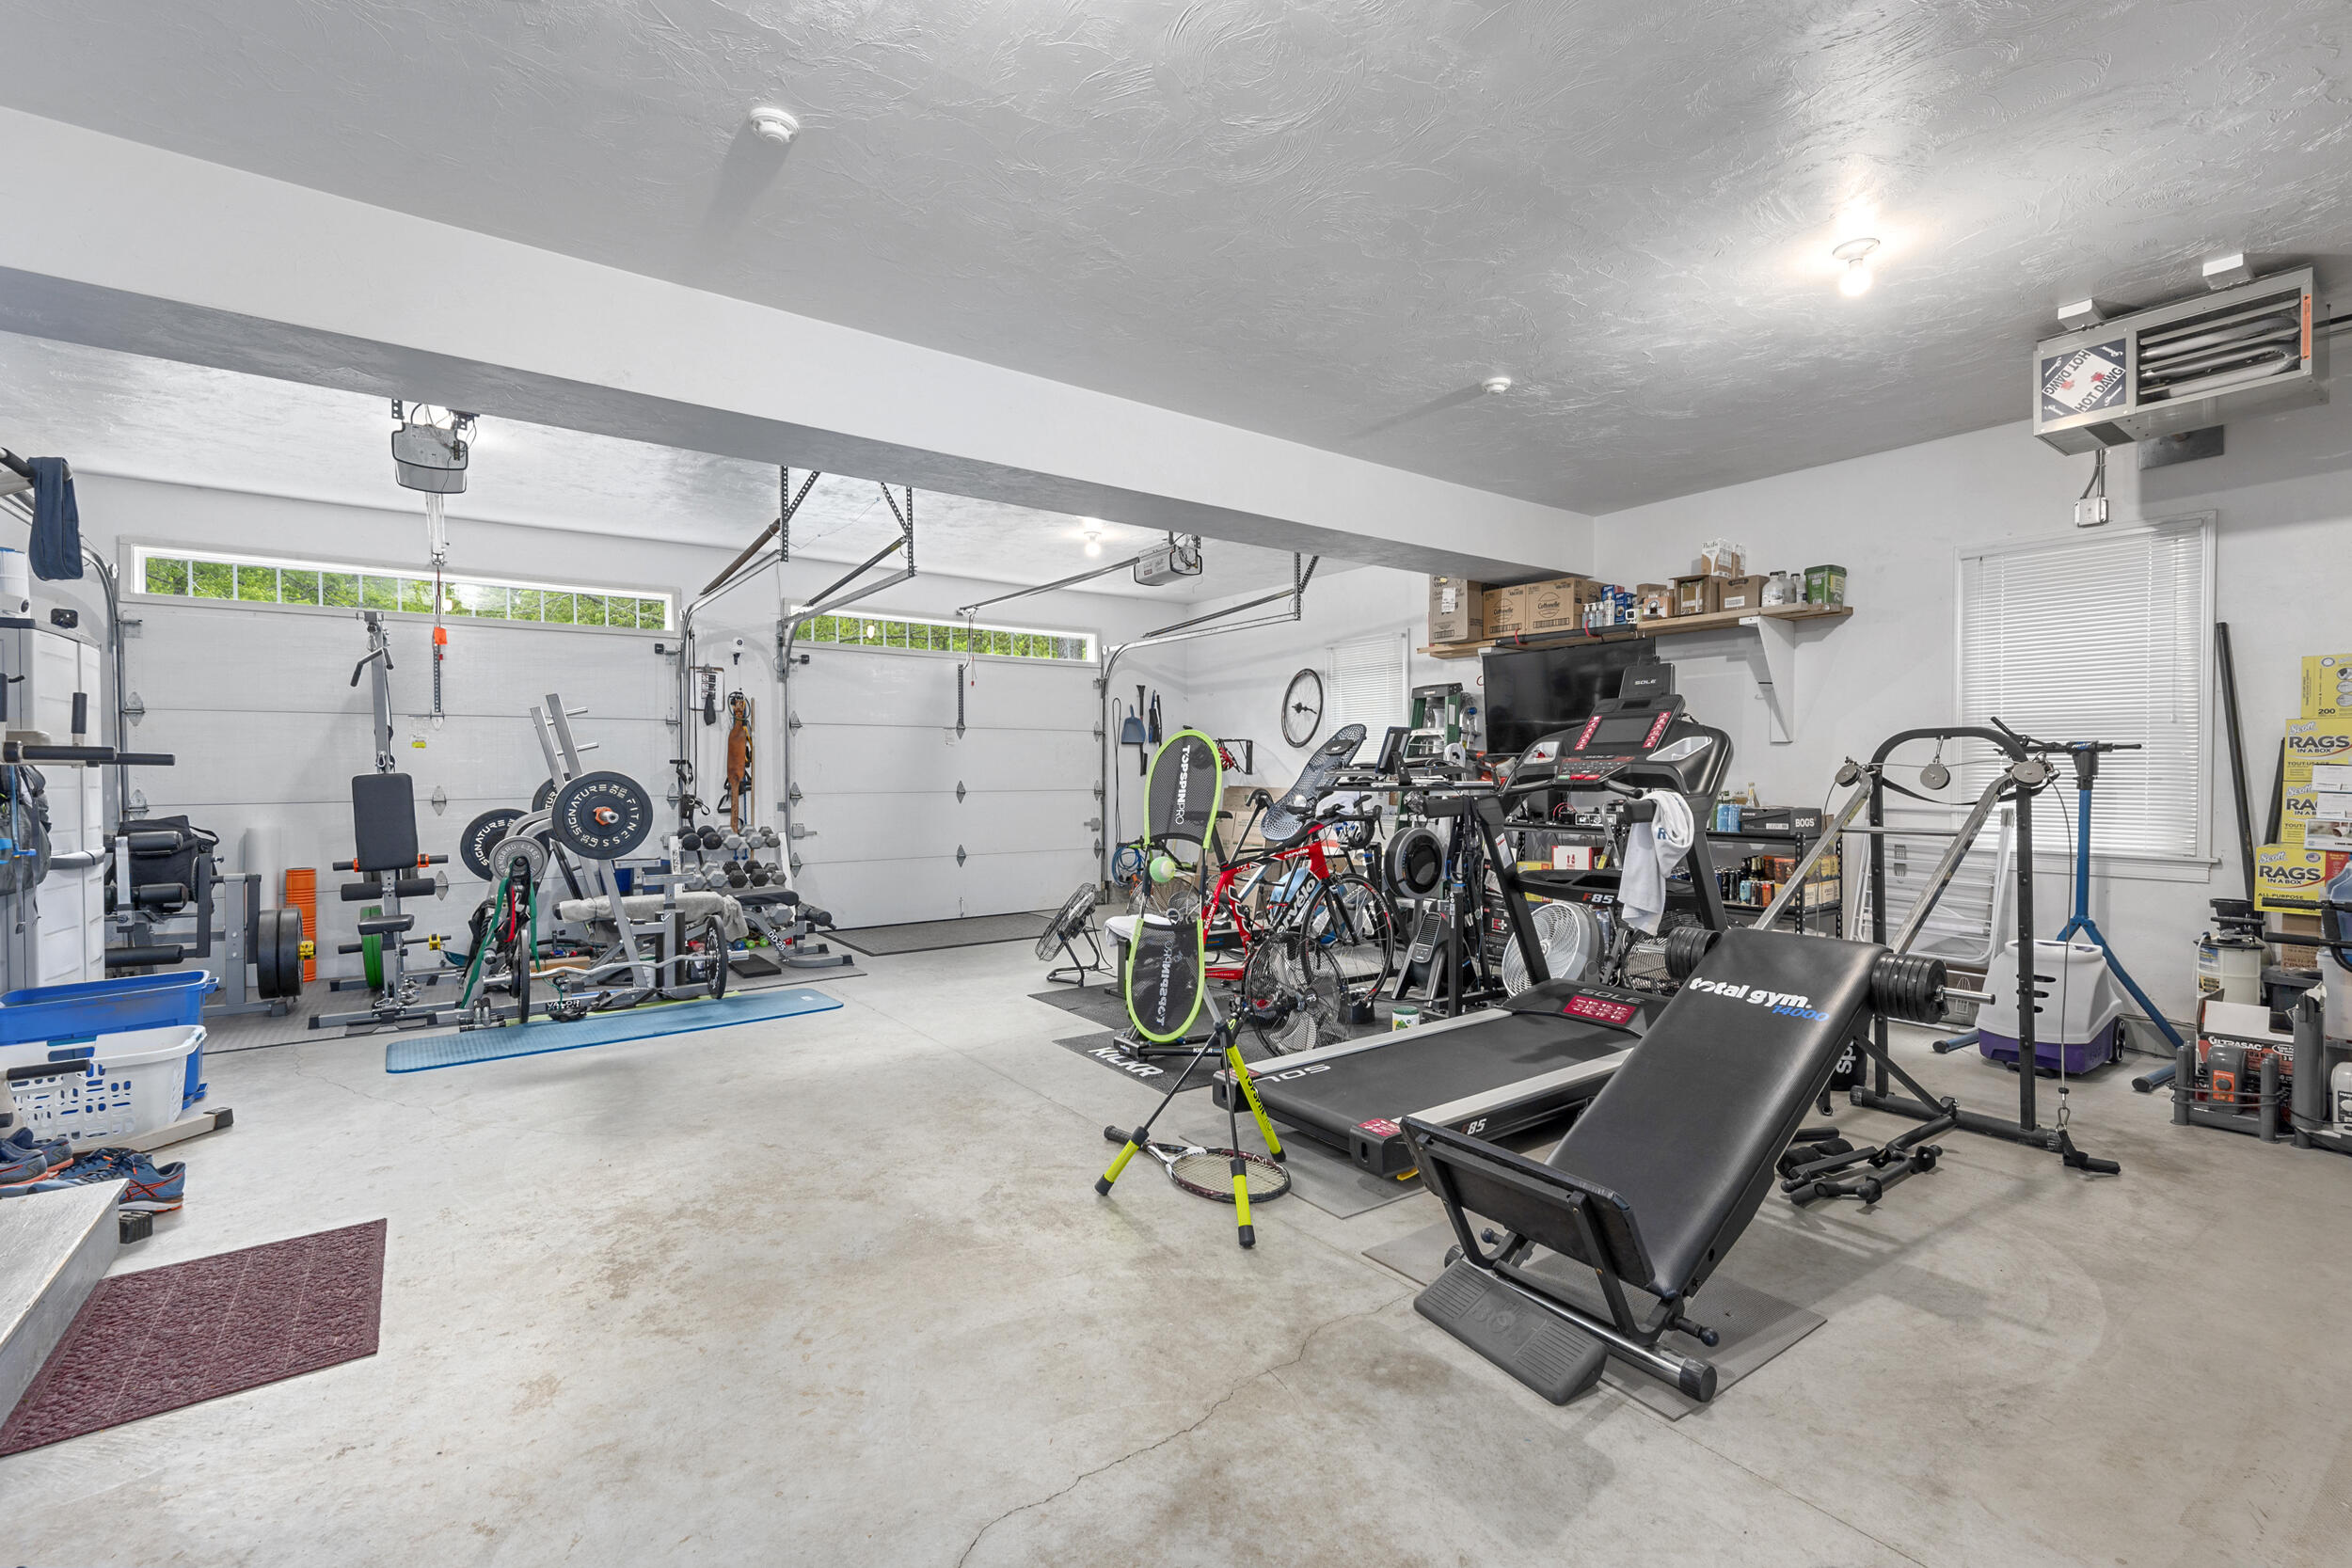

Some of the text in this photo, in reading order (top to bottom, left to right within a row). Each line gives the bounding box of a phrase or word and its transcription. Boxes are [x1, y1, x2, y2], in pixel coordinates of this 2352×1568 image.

[2073, 350, 2091, 372] HOT
[2044, 369, 2072, 395] DAWG
[2074, 391, 2097, 412] HOT
[2094, 367, 2124, 393] DAWG
[1537, 601, 1560, 610] Cottonelle
[2288, 721, 2316, 735] Scott
[2288, 736, 2350, 749] RAGS
[1175, 745, 1191, 825] TOPSPINPRO
[568, 784, 608, 835] SIGNATURE
[602, 799, 640, 847] FITNESS
[1795, 818, 1815, 828] BOGS
[474, 819, 506, 866] SIGNATURE
[580, 833, 591, 844] 35
[2259, 851, 2286, 863] Scott
[2259, 865, 2321, 880] RAGS
[1581, 892, 1614, 904] F85
[768, 931, 787, 951] DD-25
[1578, 988, 1646, 1005] SOLE
[1689, 977, 1750, 999] total
[1772, 1005, 1830, 1023] 14000
[1088, 1046, 1165, 1078] KICKR
[1460, 1117, 1487, 1135] F85
